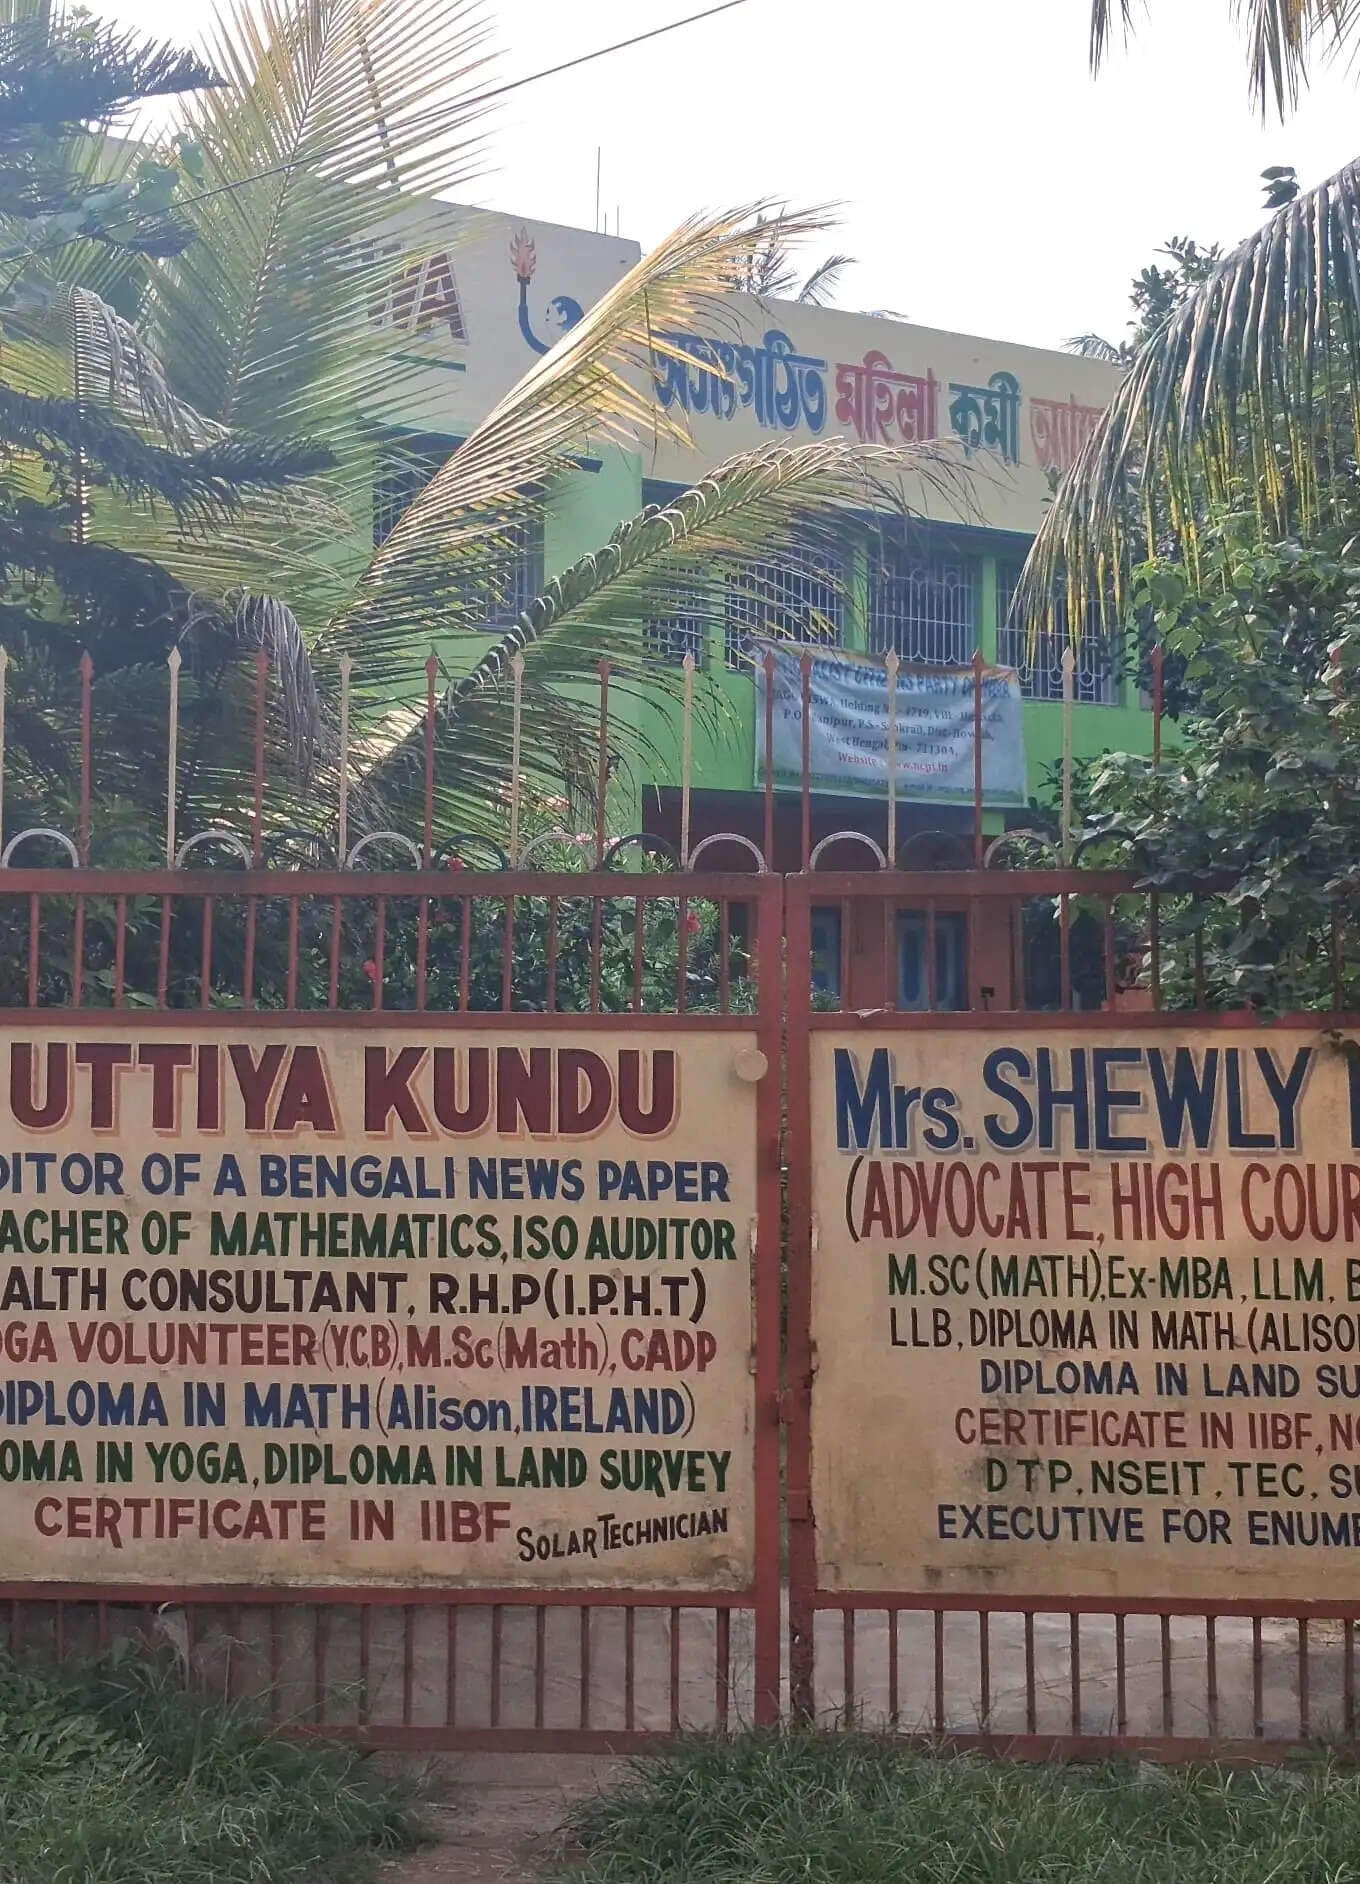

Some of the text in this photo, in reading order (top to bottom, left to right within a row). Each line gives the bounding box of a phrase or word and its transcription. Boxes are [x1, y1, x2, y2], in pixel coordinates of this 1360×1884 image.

[835, 350, 939, 444] মহিলা
[9, 1041, 680, 1141] UTTIYA KUNDU
[833, 1047, 976, 1154] Mrs.
[981, 1045, 1315, 1154] SHEWLY
[140, 1152, 202, 1197] OF
[212, 1153, 247, 1197] A
[259, 1154, 456, 1200] BENGALI
[467, 1157, 585, 1202] NEWS
[597, 1159, 732, 1203] PAPER
[1110, 1161, 1227, 1242] HIGH
[140, 1210, 193, 1256] OF
[584, 1216, 738, 1261] AUDITOR
[120, 1268, 416, 1319] CONSULTANT,
[428, 1267, 708, 1325] R.H.P(I.P.H.T)
[620, 1327, 718, 1373] CADP
[969, 1307, 1098, 1350] DIPLOMA
[1108, 1309, 1141, 1350] IN
[1151, 1310, 1236, 1352] MATH
[980, 1358, 1140, 1396] DIPLOMA
[1155, 1362, 1189, 1397] IN
[1202, 1362, 1301, 1398] LAND
[182, 1381, 227, 1428] IN
[954, 1407, 1187, 1449] CERTIFICATE
[1200, 1411, 1235, 1450] IN
[95, 1440, 134, 1484] IN
[264, 1443, 437, 1486] DIPLOMA
[445, 1445, 483, 1487] IN
[495, 1446, 588, 1488] LAND
[599, 1448, 733, 1498] SURVEY
[33, 1496, 512, 1549] CERTIFICATE IN IIBF
[936, 1503, 1145, 1543] EXECUTIVE
[1162, 1507, 1233, 1545] FOR
